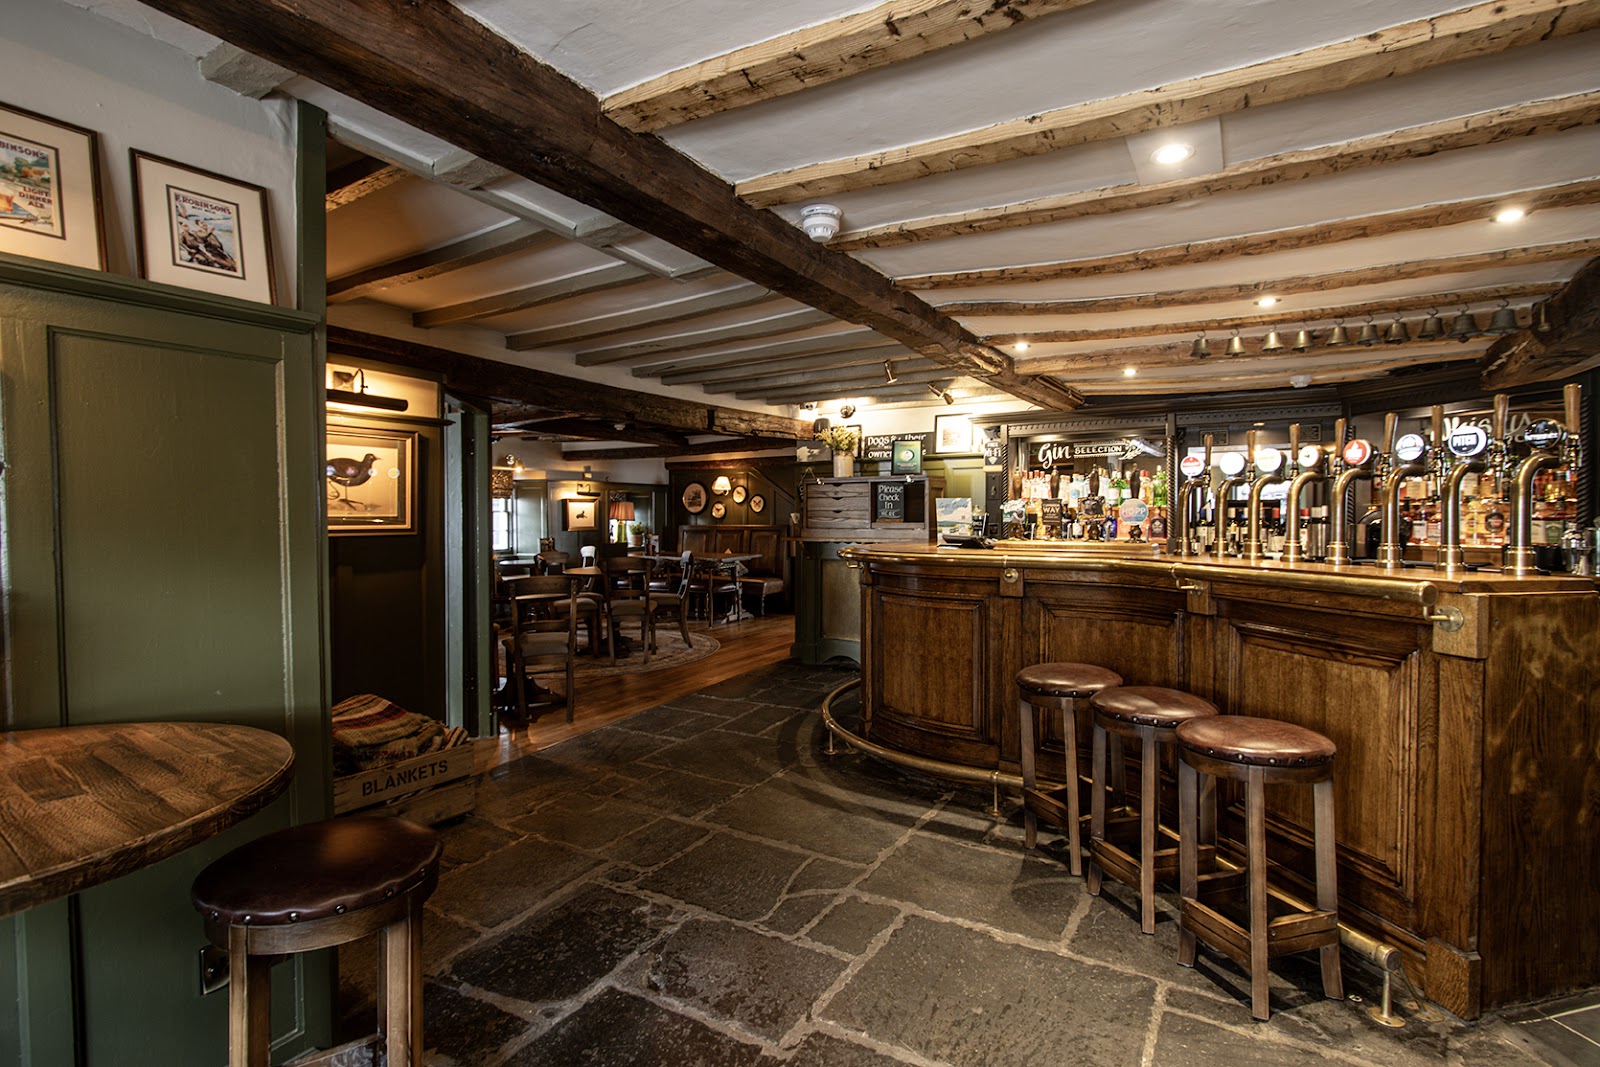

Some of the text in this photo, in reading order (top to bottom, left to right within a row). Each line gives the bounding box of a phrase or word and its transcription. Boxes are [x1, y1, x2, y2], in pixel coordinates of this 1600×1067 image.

[0, 141, 46, 160] BINSON'S
[18, 191, 53, 204] DINNER
[23, 186, 49, 197] LIGHT
[28, 200, 46, 209] ALE
[1038, 442, 1122, 469] Gin SELECTION
[878, 484, 904, 494] Please
[878, 493, 900, 501] Check
[362, 760, 448, 796] BLANKETS
